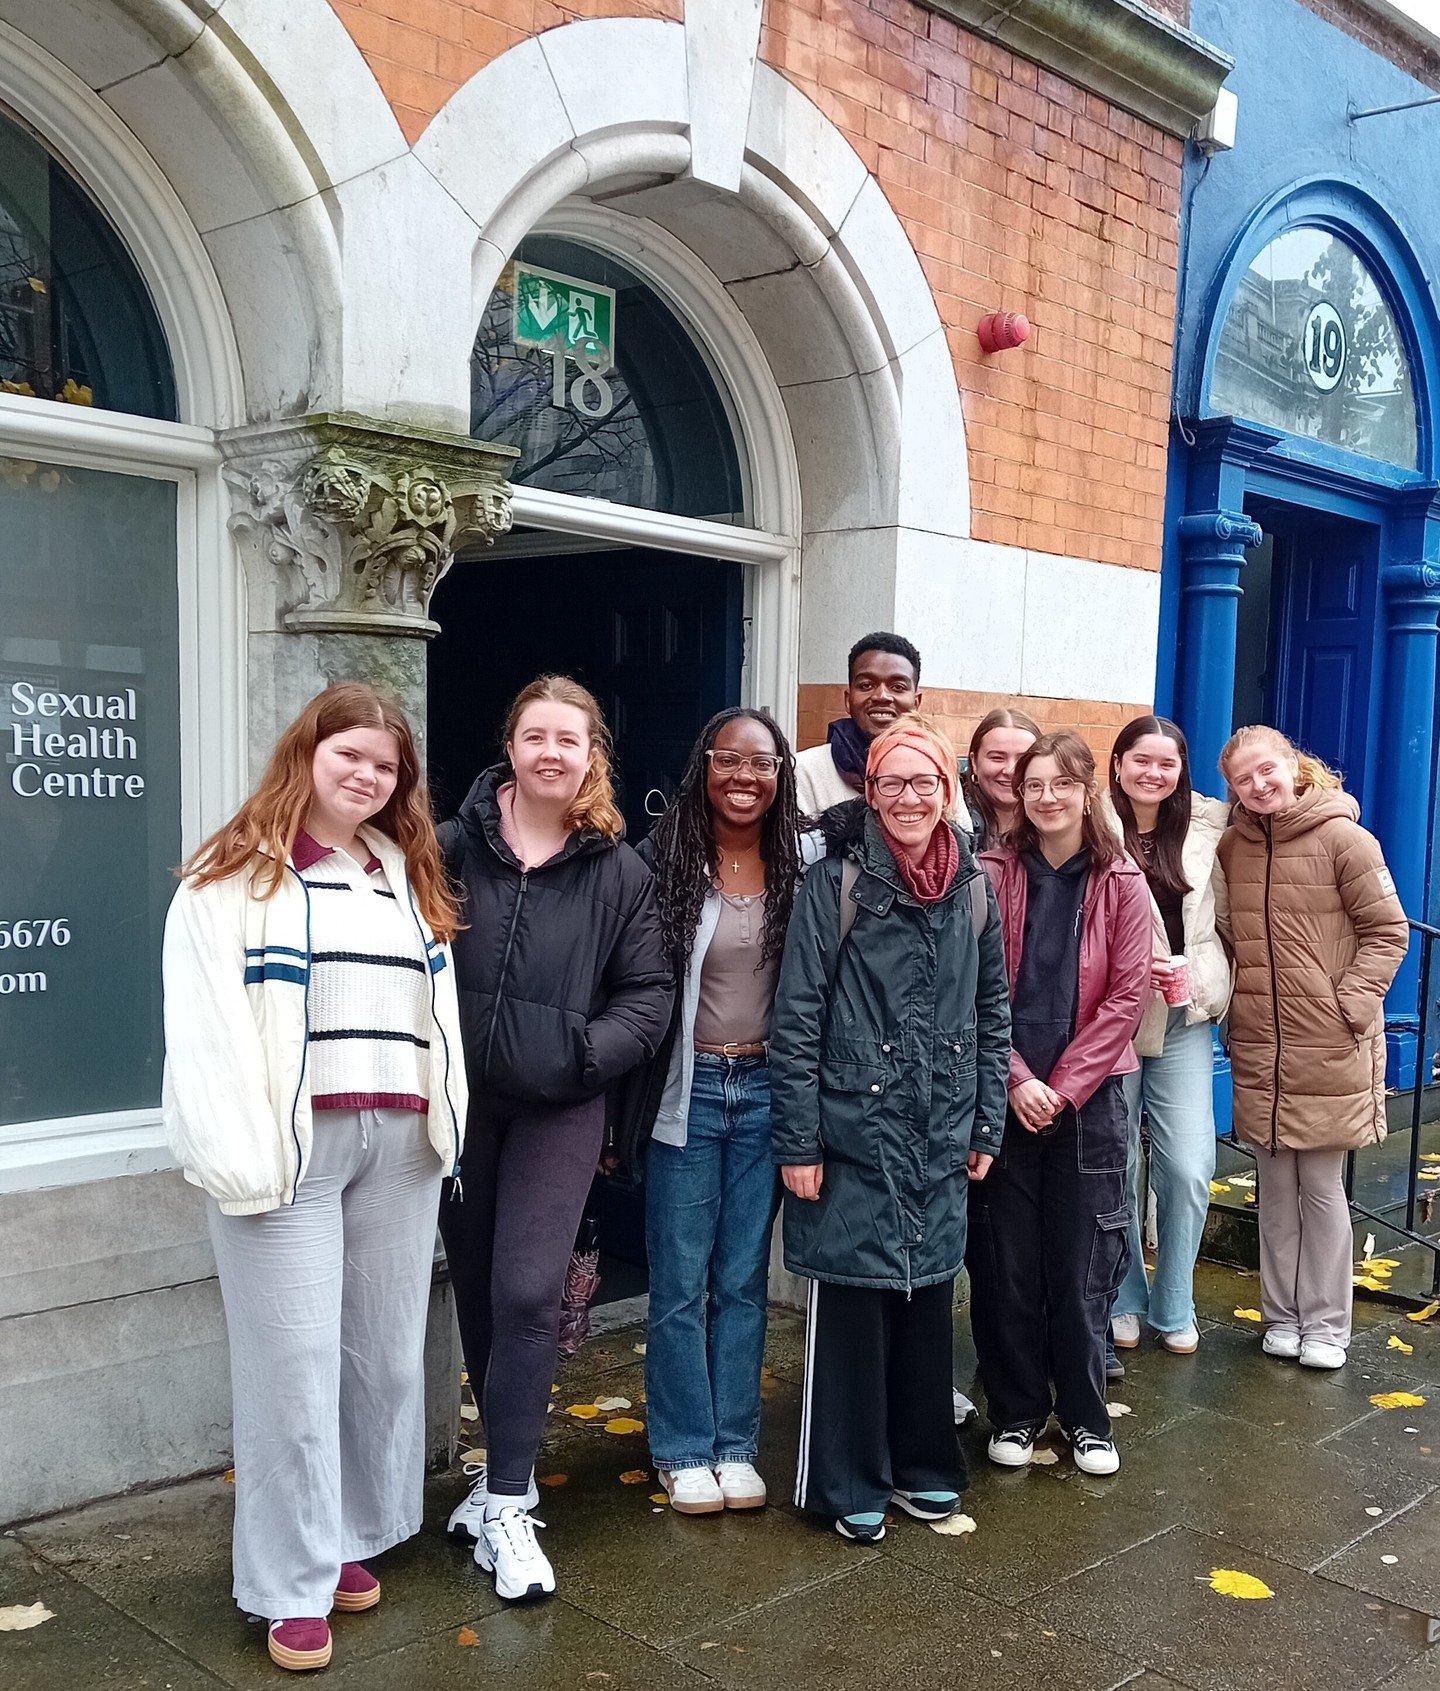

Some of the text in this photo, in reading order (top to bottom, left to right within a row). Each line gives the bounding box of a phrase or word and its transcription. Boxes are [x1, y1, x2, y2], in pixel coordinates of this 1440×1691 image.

[1310, 315, 1342, 378] 19
[545, 331, 613, 417] 18
[11, 681, 136, 720] Sexual
[11, 723, 137, 759] Health
[12, 763, 145, 798] Centre
